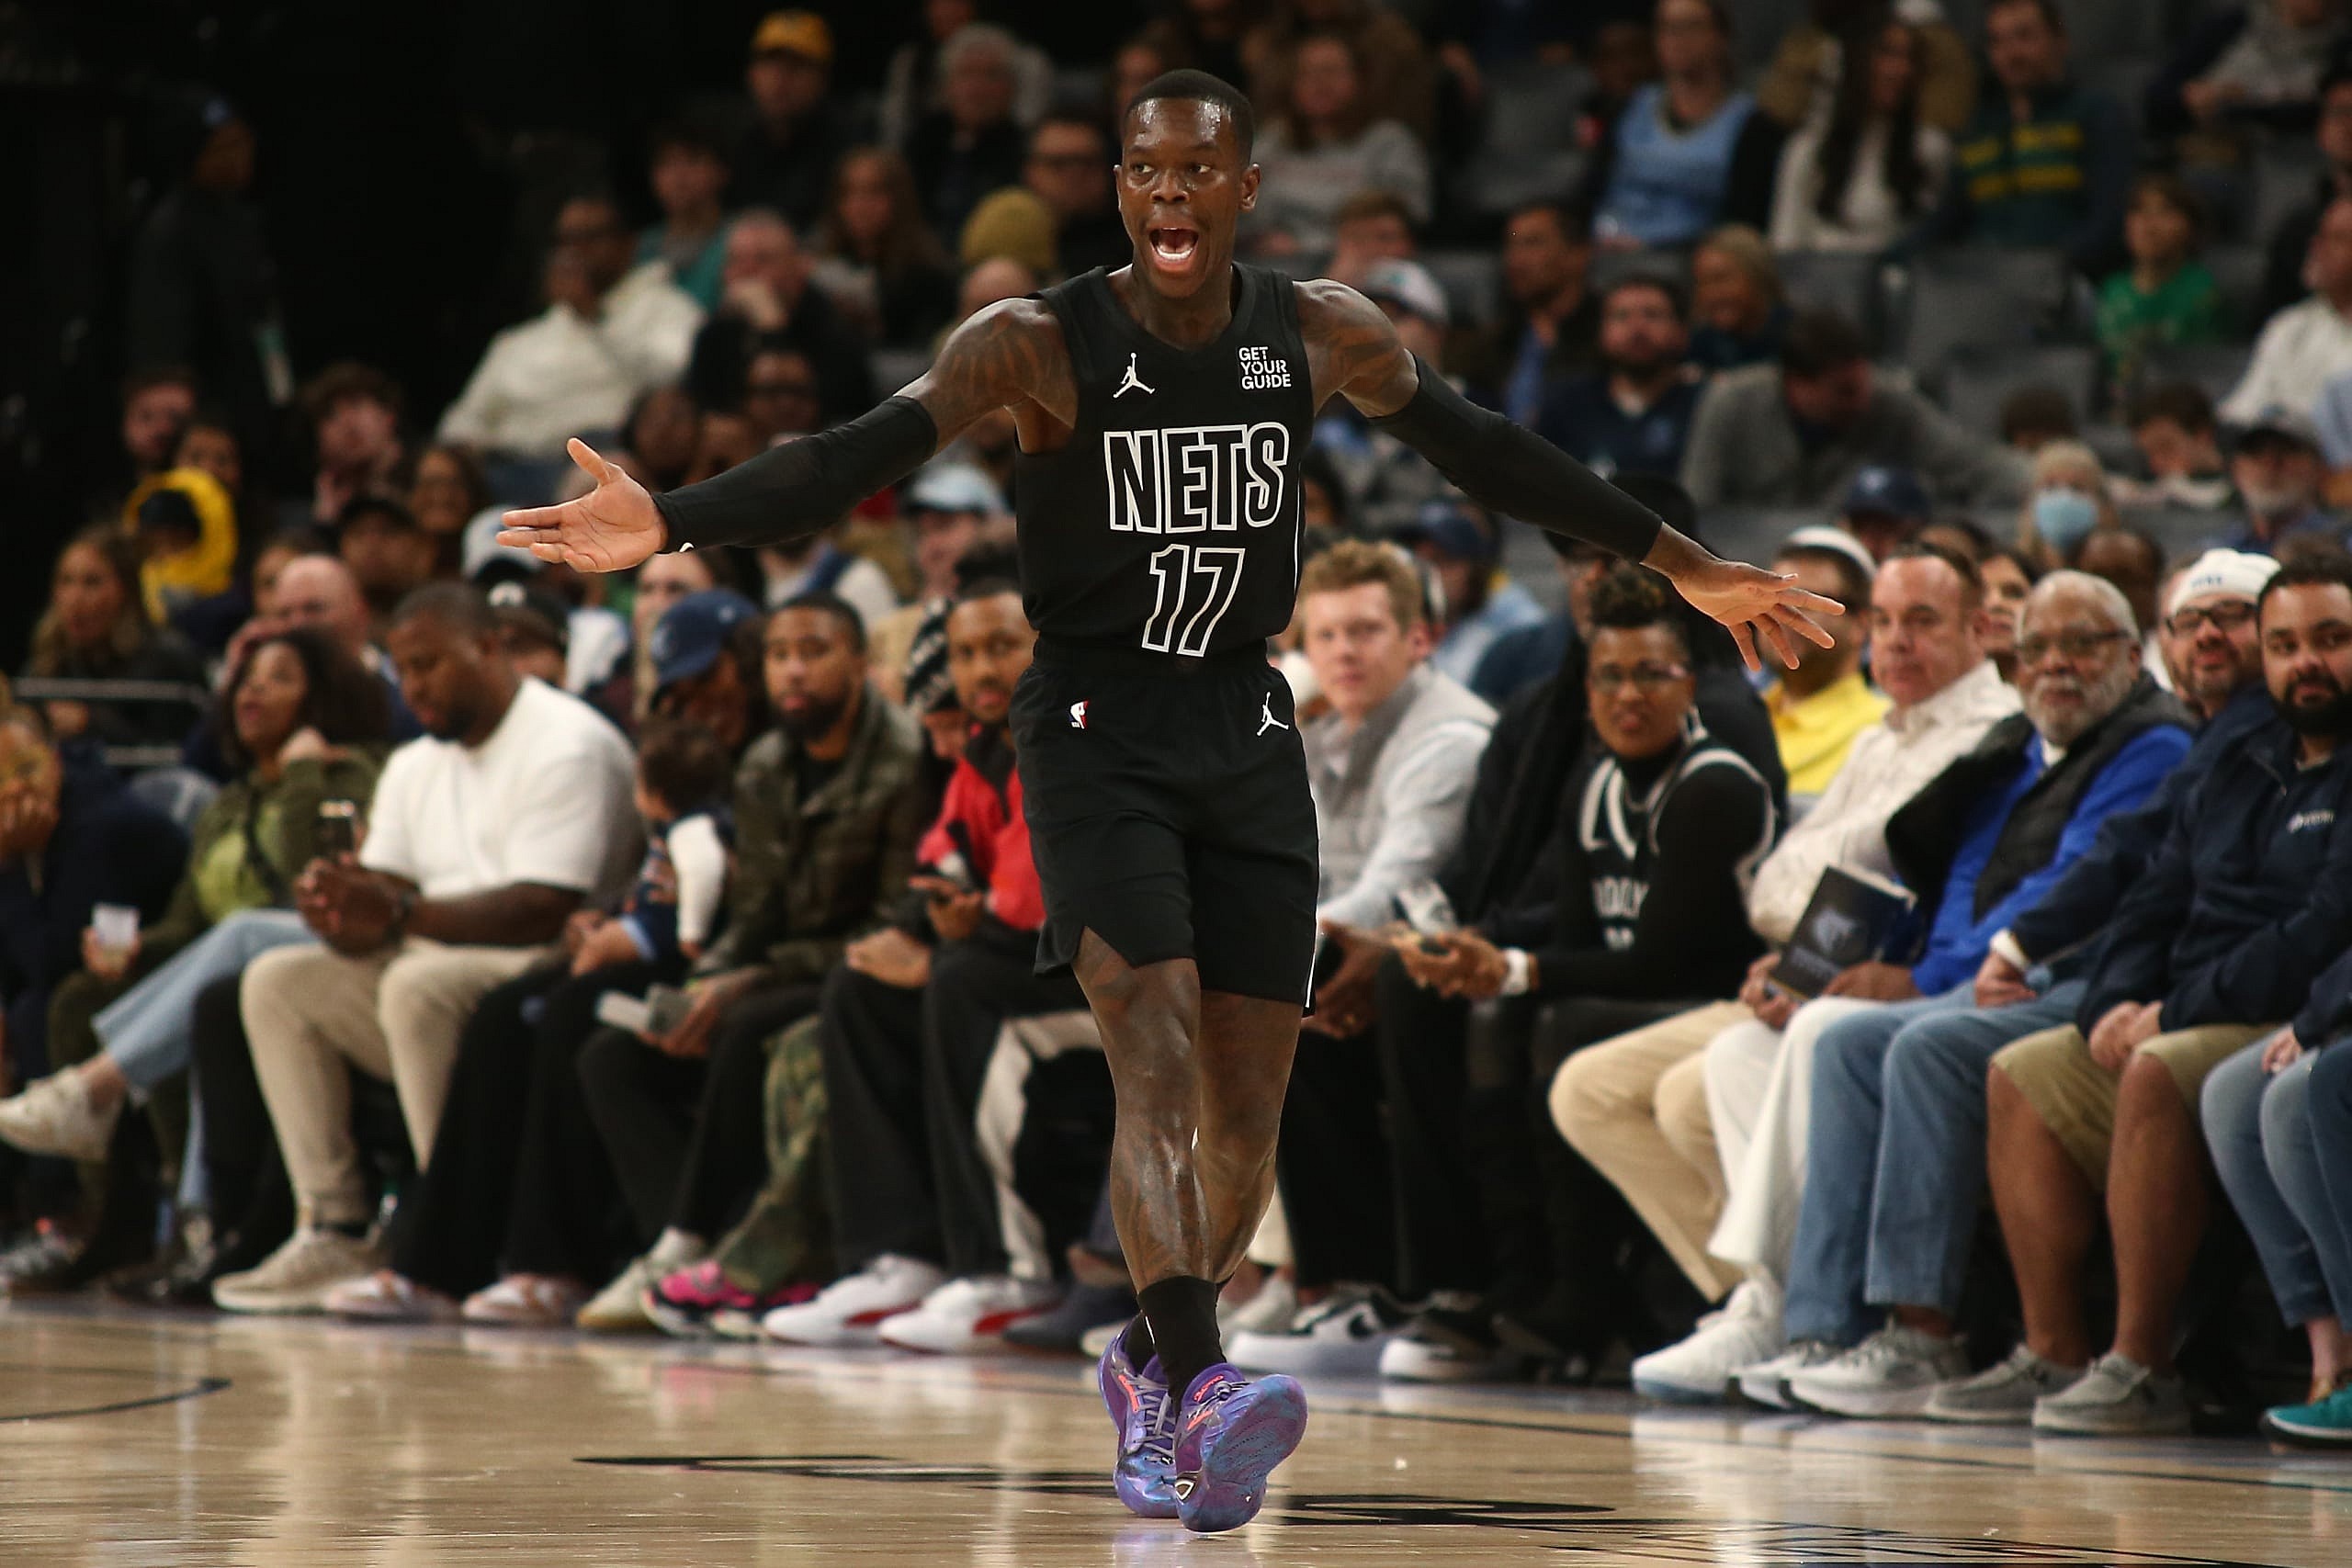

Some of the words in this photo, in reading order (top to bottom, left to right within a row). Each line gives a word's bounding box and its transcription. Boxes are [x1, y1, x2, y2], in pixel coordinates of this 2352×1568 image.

[1238, 346, 1269, 361] GET
[1240, 359, 1287, 376] YOUR
[1241, 373, 1292, 389] GUIDE
[1103, 422, 1290, 535] NETS
[1141, 543, 1246, 658] 17
